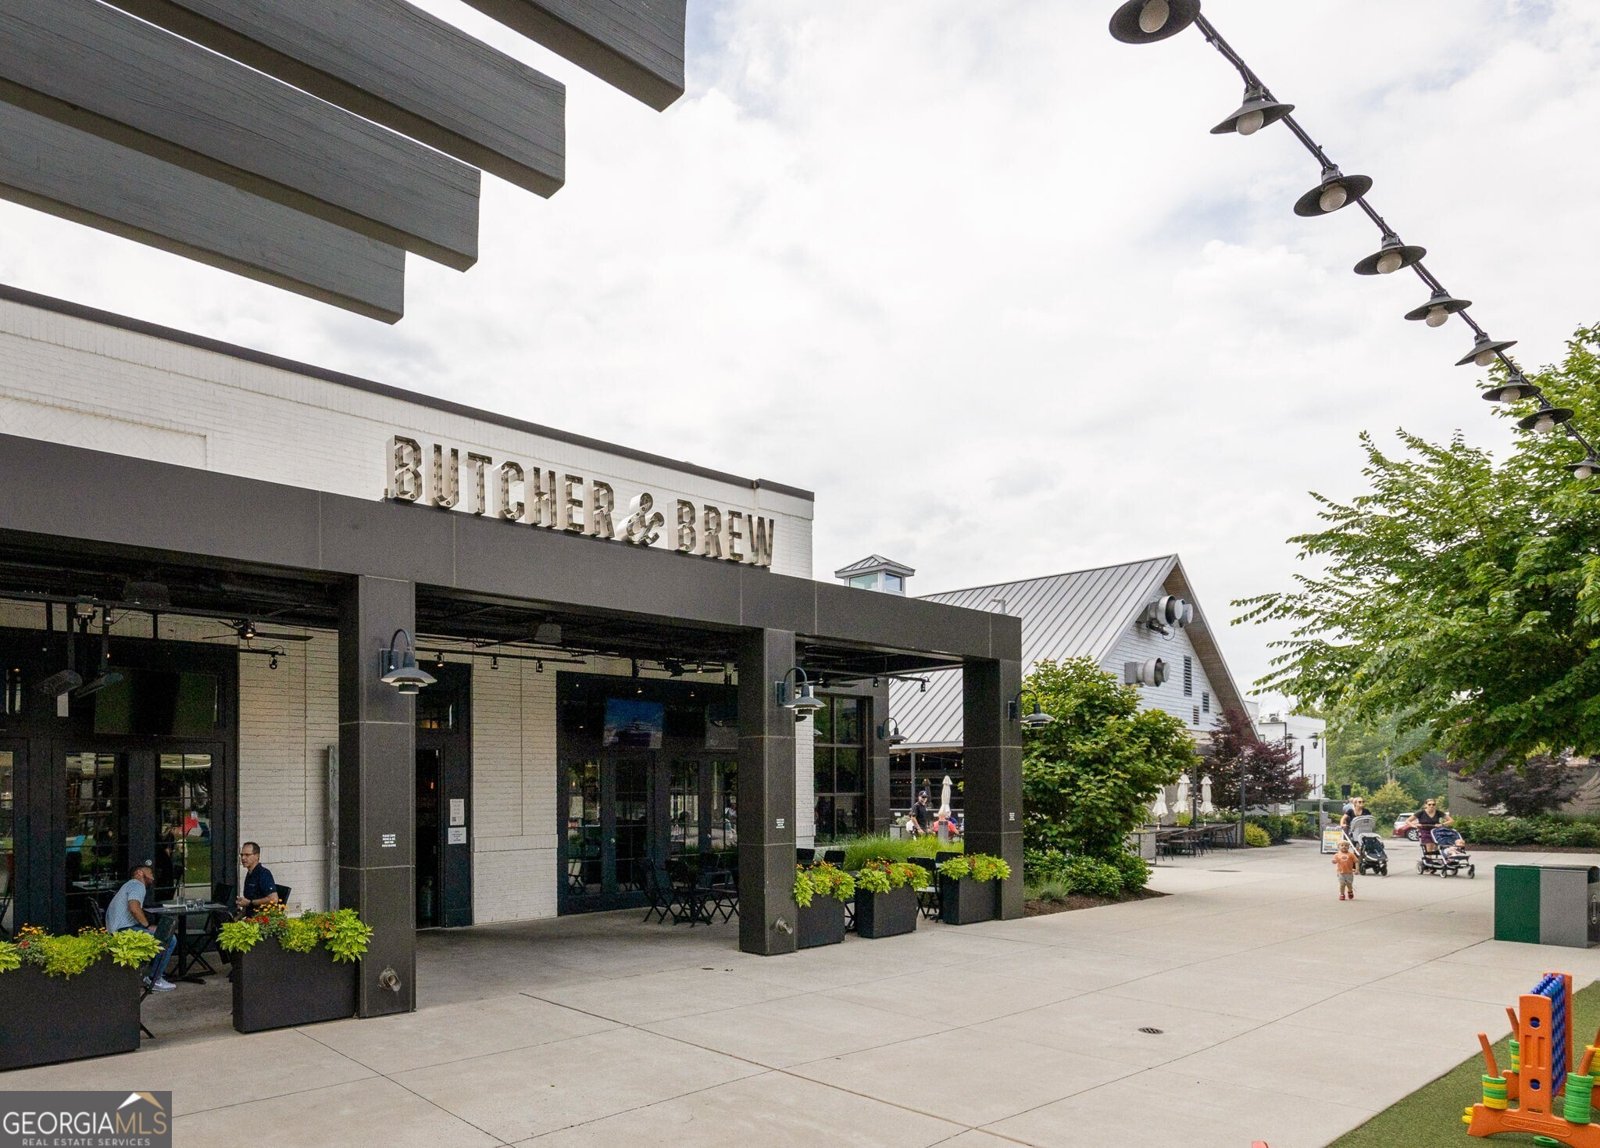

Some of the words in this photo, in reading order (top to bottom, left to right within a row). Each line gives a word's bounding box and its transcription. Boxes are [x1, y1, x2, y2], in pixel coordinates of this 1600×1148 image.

[386, 434, 615, 538] BUTCHER
[616, 492, 666, 546] &
[668, 498, 775, 566] BREW
